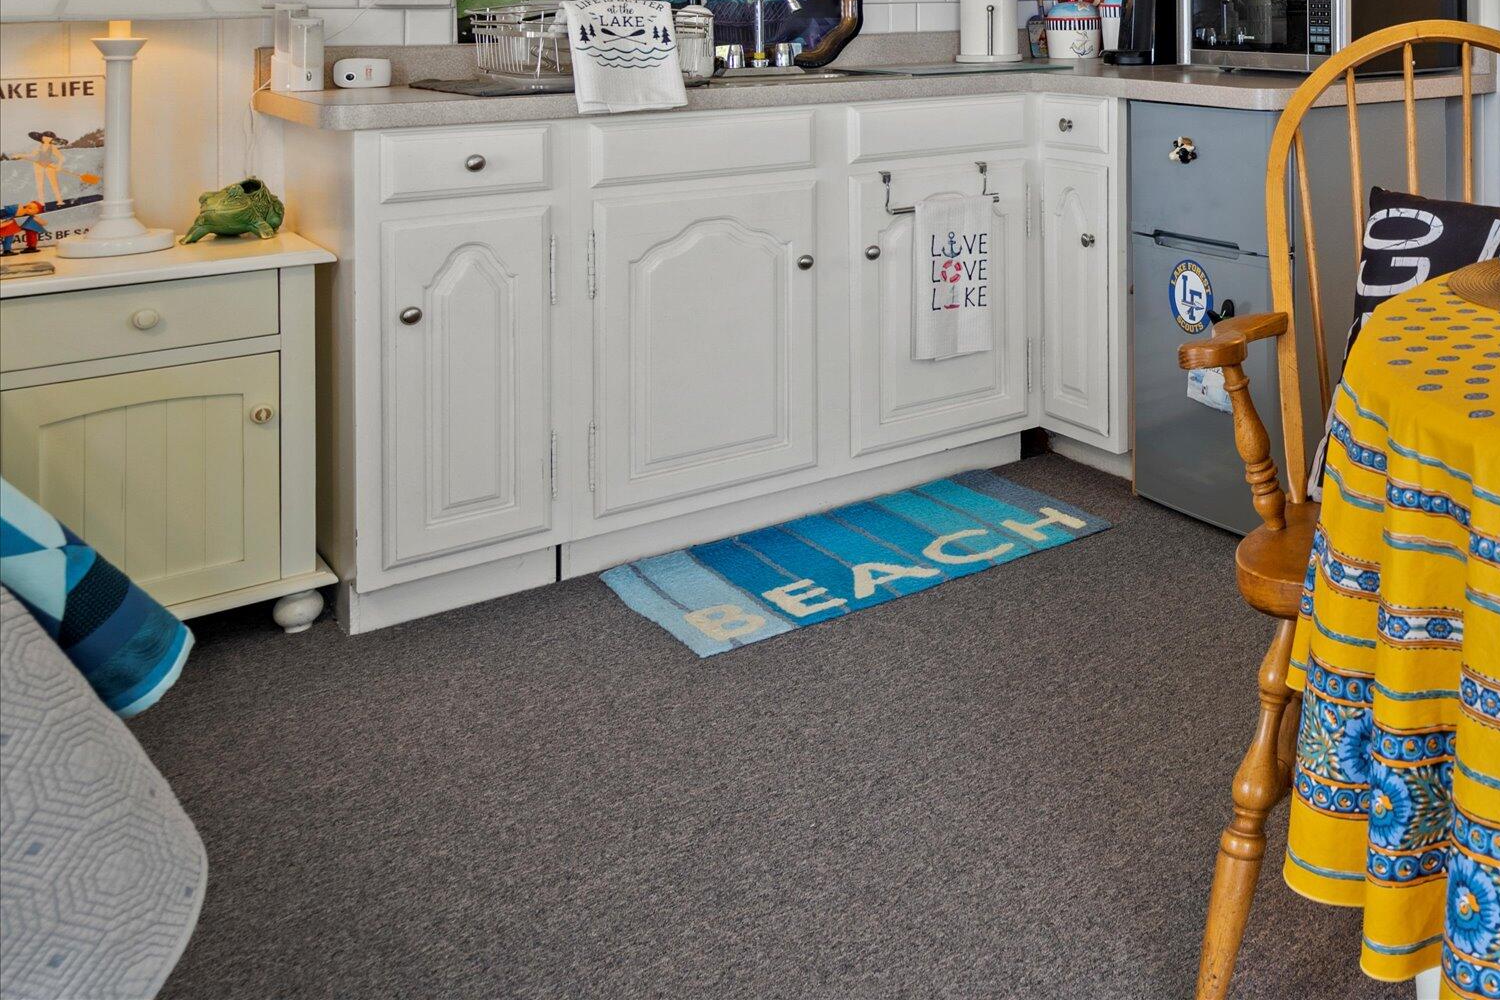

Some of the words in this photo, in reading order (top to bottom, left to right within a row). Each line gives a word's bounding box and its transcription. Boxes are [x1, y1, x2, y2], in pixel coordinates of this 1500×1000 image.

[600, 15, 645, 27] LAKE
[0, 83, 38, 99] KE
[48, 81, 95, 98] LIFE
[1171, 262, 1187, 286] LAKE
[1188, 262, 1212, 295] FOREST
[932, 285, 987, 311] LKE
[1176, 315, 1204, 333] SCOUTS
[683, 506, 1086, 642] BEACH
